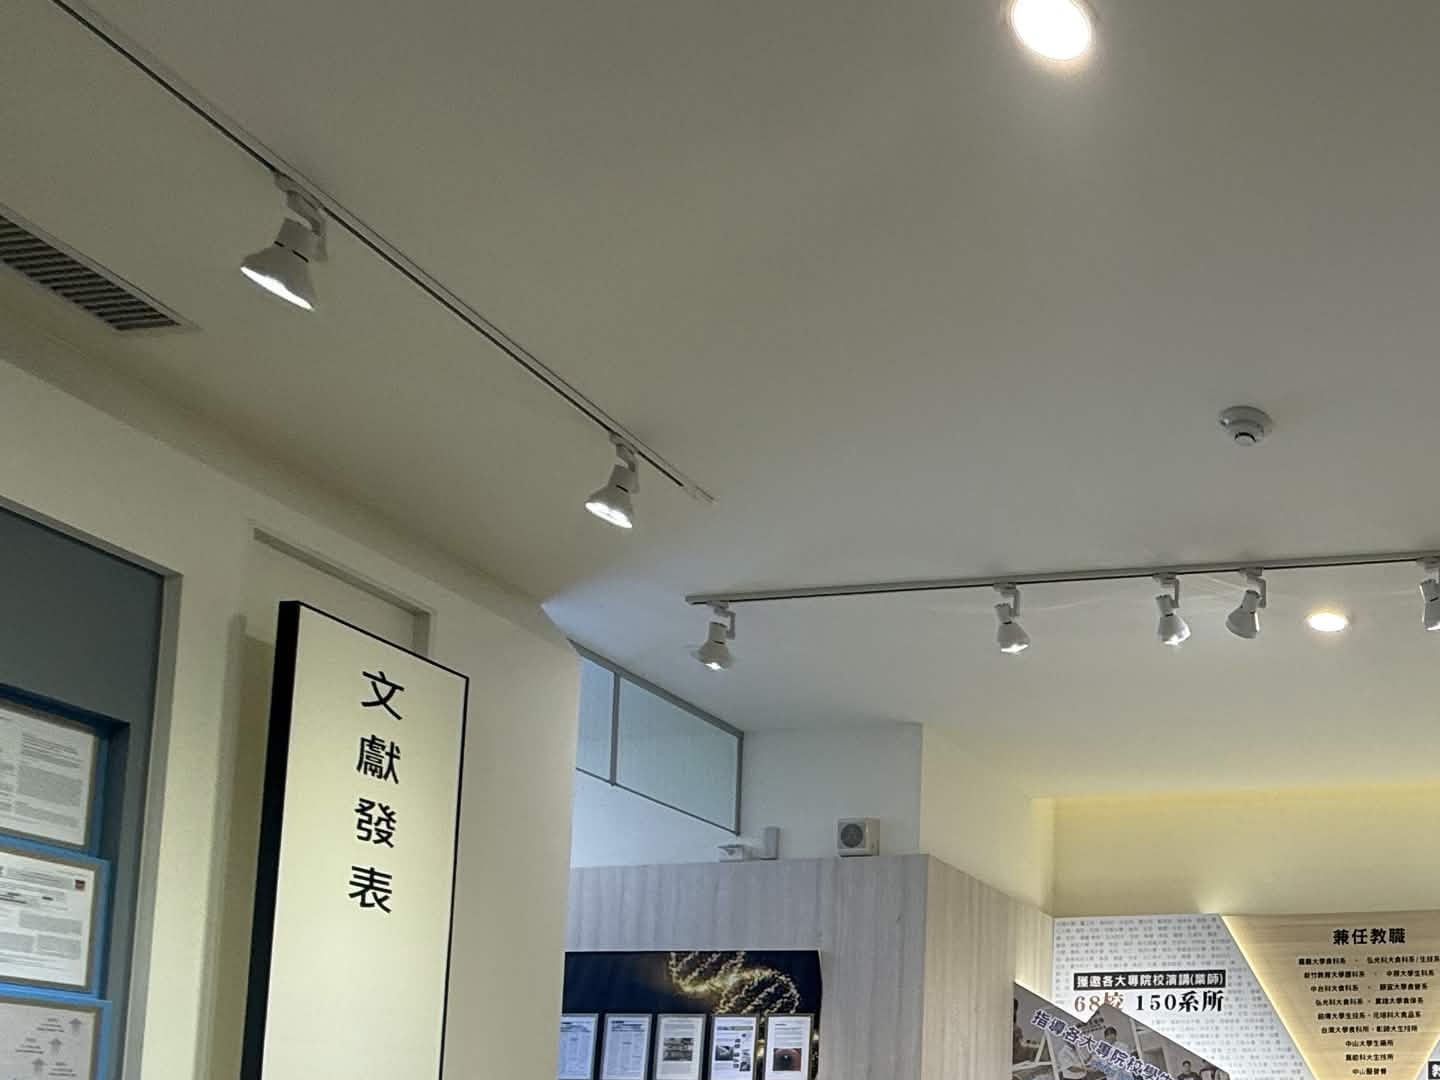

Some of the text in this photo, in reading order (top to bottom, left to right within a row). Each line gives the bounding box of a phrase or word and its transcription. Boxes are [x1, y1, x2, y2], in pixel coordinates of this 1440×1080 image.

[347, 669, 406, 915] 文獻發表
[1332, 928, 1406, 945] 兼任教職
[1135, 990, 1225, 1013] 150系所
